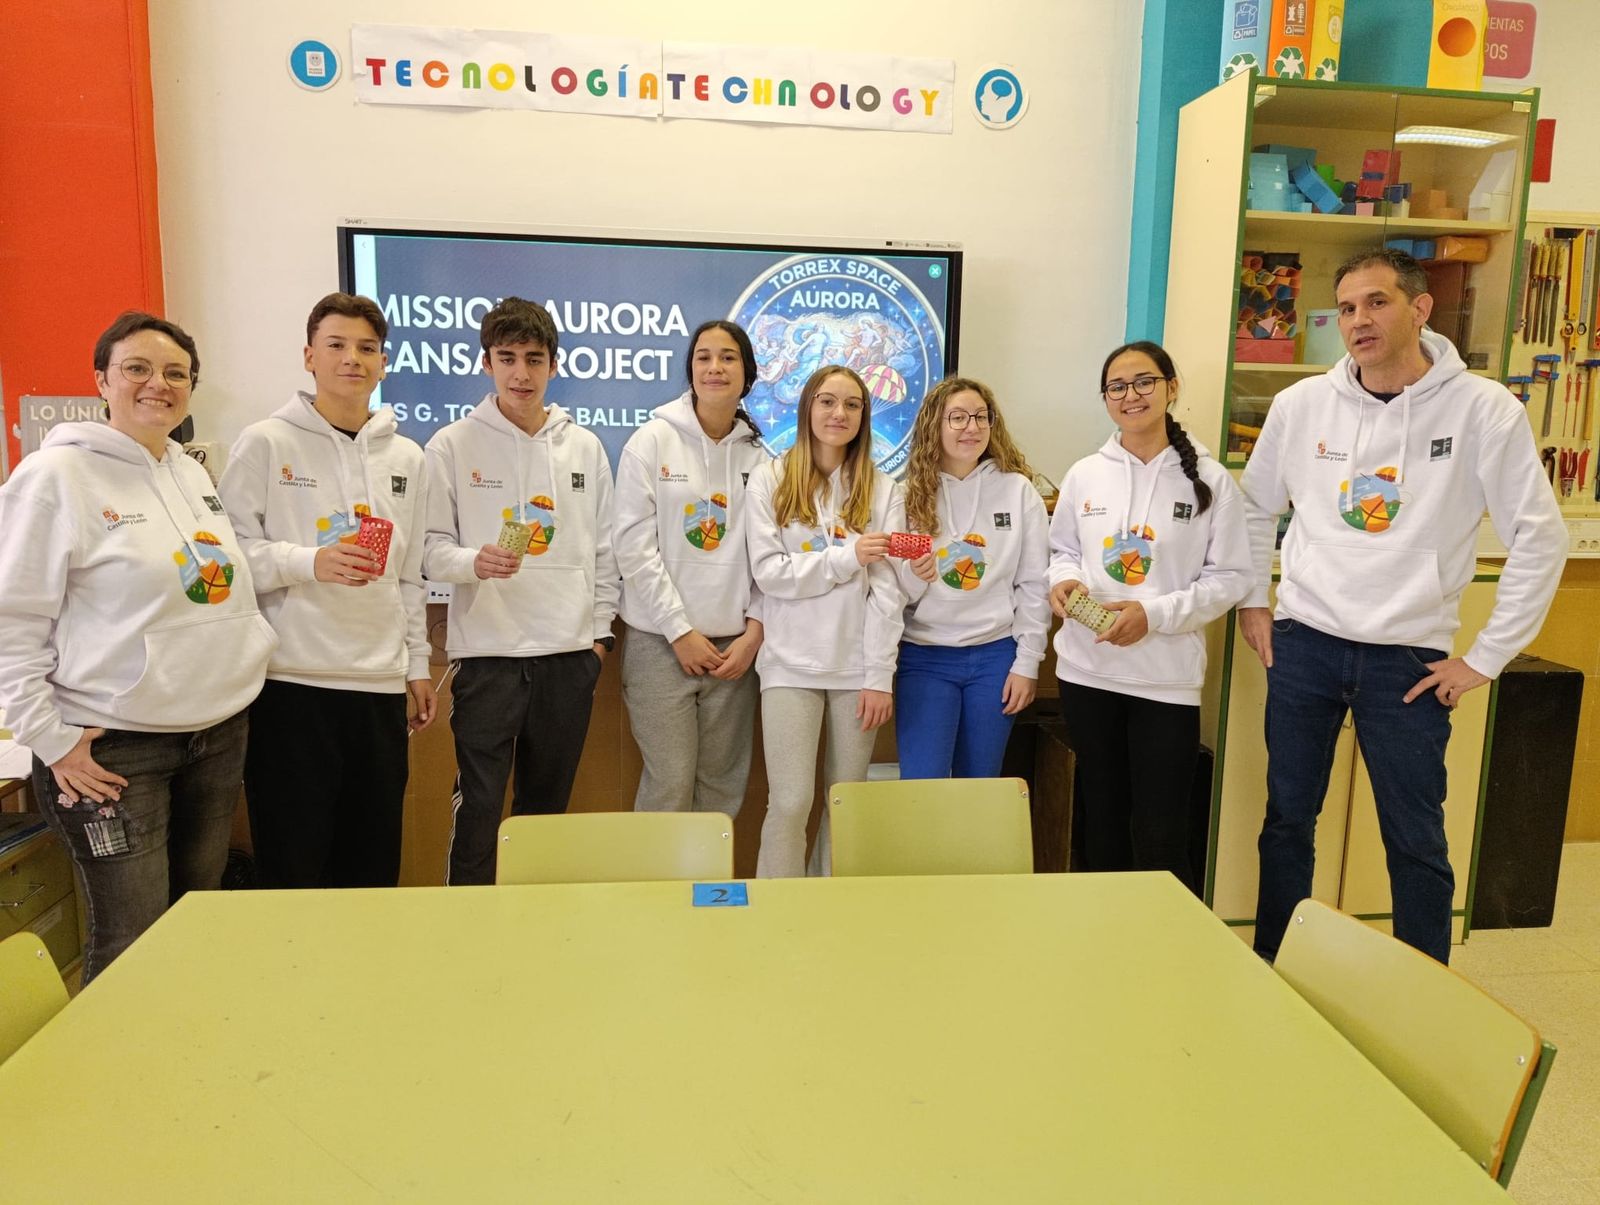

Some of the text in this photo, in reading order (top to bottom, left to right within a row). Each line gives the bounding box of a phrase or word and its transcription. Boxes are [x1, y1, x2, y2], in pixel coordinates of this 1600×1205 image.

[1487, 17, 1524, 32] IENTAS
[366, 58, 939, 116] TECNOLOGÍA TECHNOLOGY
[769, 259, 902, 296] TORREX SPACE
[790, 290, 880, 310] AURORA
[376, 294, 689, 336] MISSIO AURORA
[555, 346, 673, 380] ROJECT
[30, 400, 107, 421] LO ÚNIC
[414, 403, 439, 422] G.
[711, 888, 729, 903] 2
